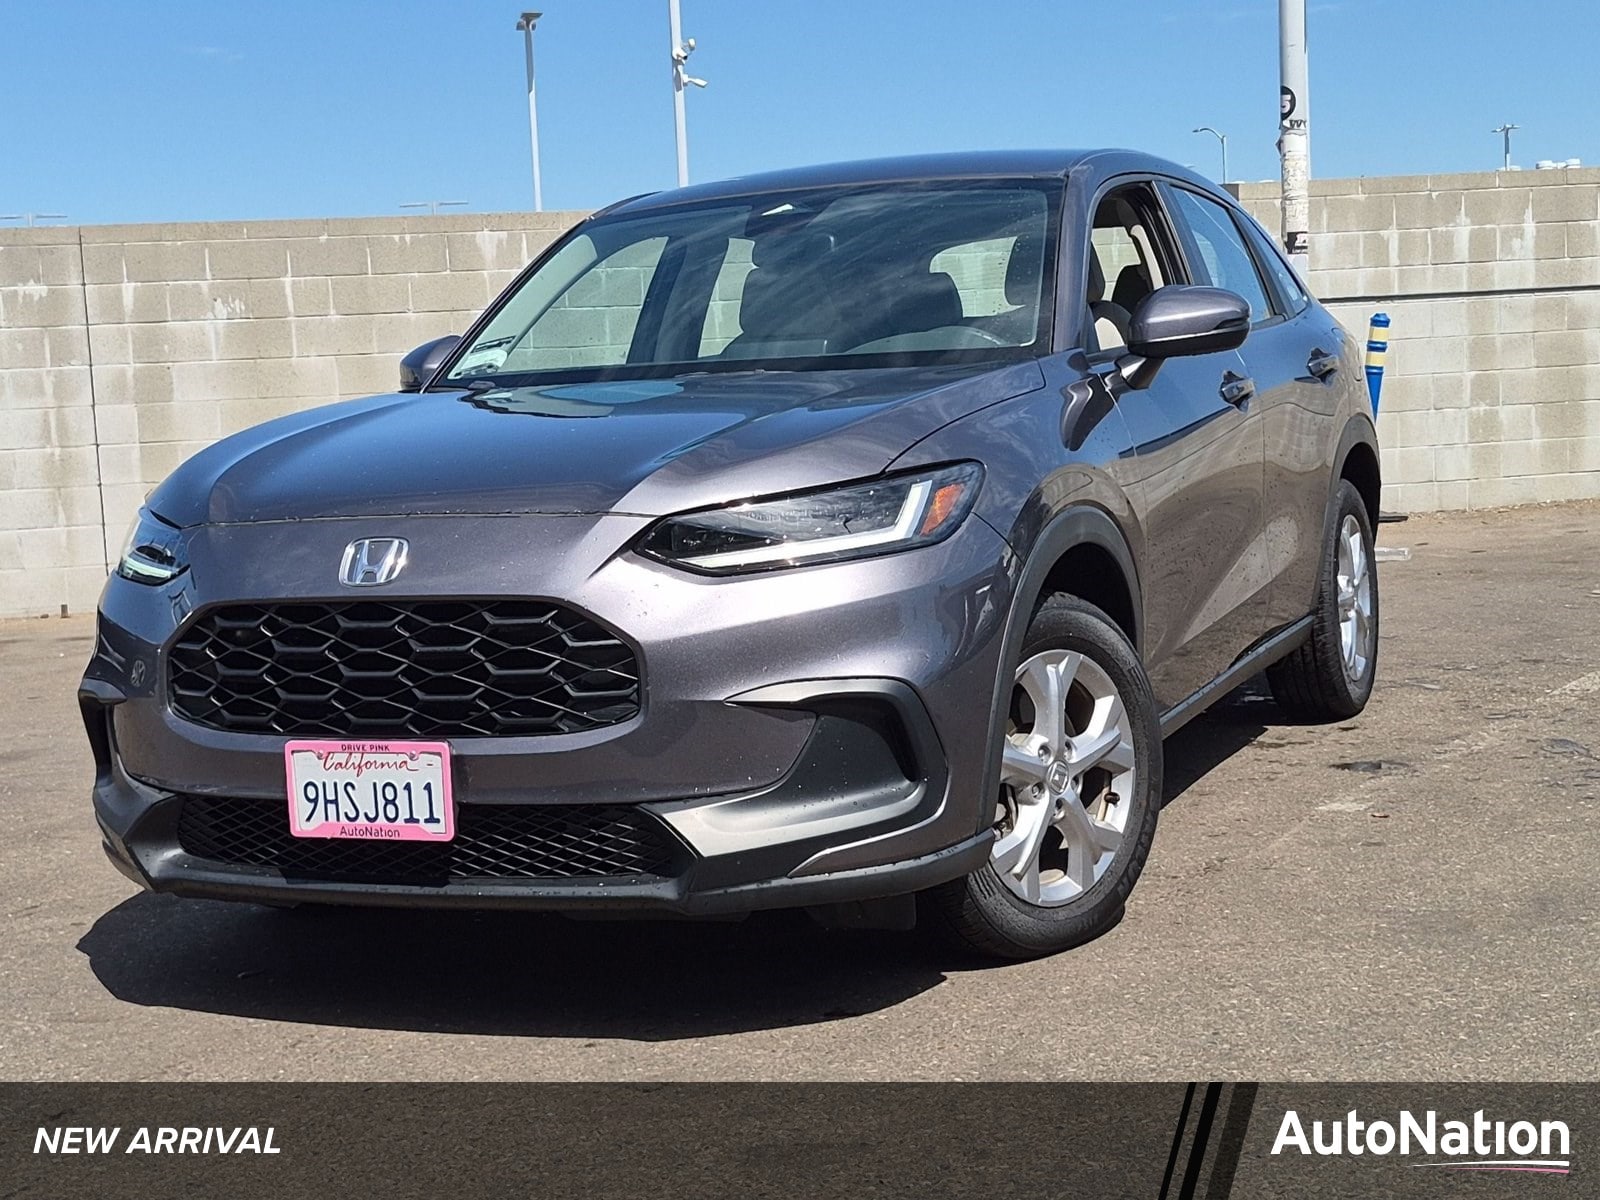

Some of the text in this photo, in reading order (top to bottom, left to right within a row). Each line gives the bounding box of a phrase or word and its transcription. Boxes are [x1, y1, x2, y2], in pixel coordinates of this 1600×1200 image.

[323, 751, 419, 777] California
[303, 780, 441, 824] 9HSJ811
[339, 825, 400, 838] AutoNation
